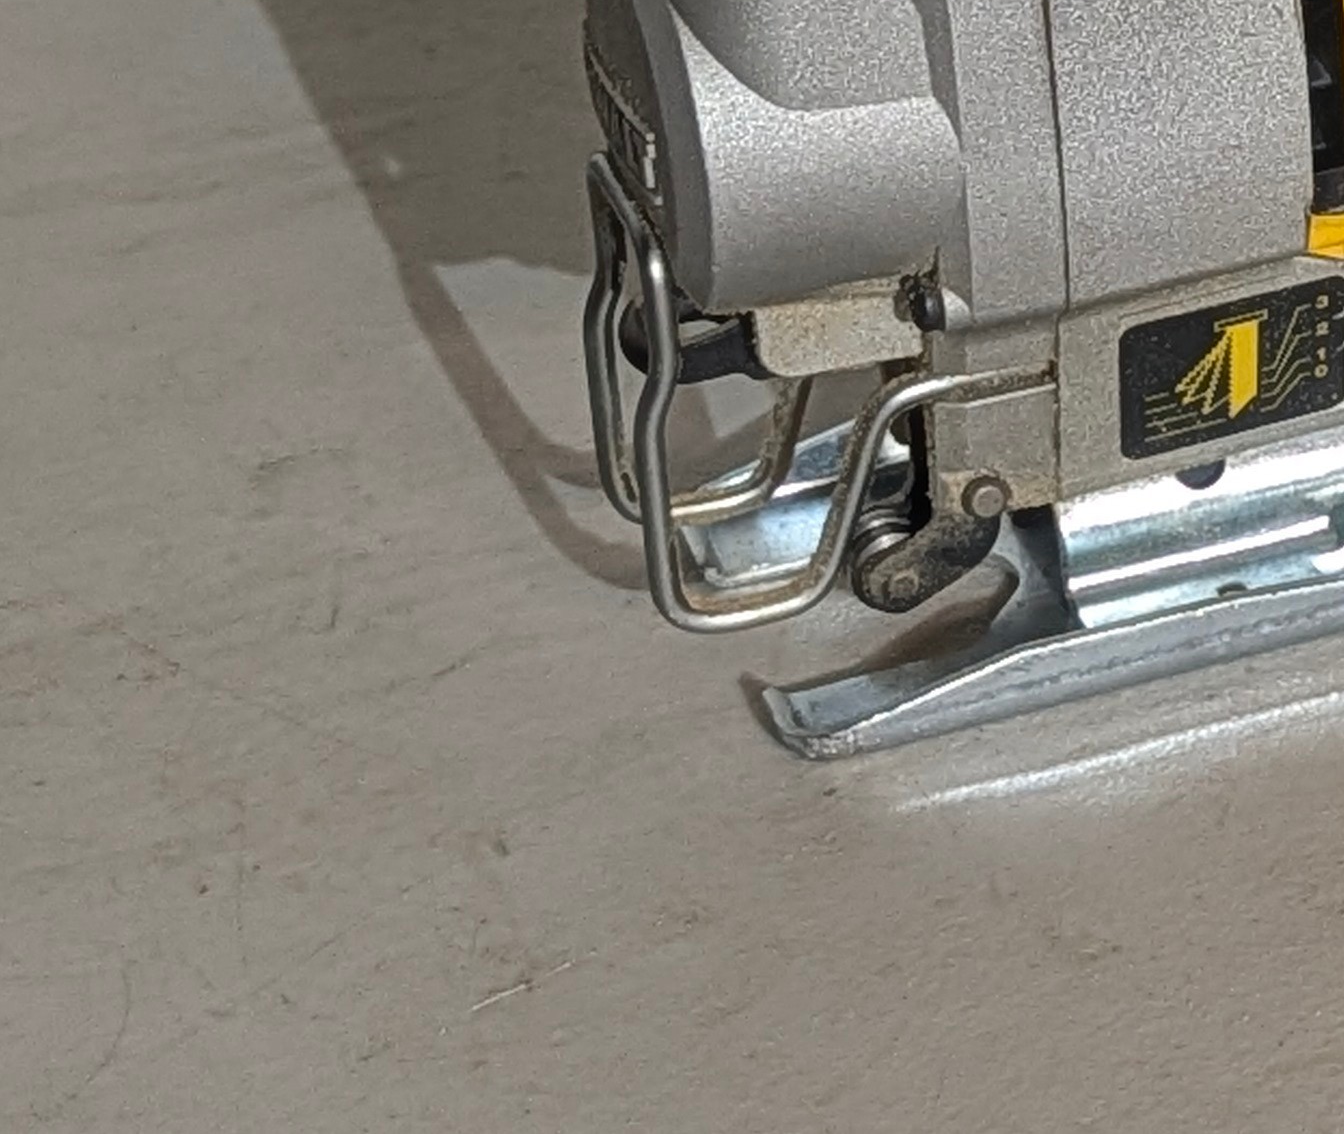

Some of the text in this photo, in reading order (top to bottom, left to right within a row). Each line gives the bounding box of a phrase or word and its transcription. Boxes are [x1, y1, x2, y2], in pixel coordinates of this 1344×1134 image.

[1314, 294, 1329, 309] 3
[1314, 321, 1329, 336] 2
[1316, 347, 1327, 361] 1
[1314, 363, 1329, 378] 0
